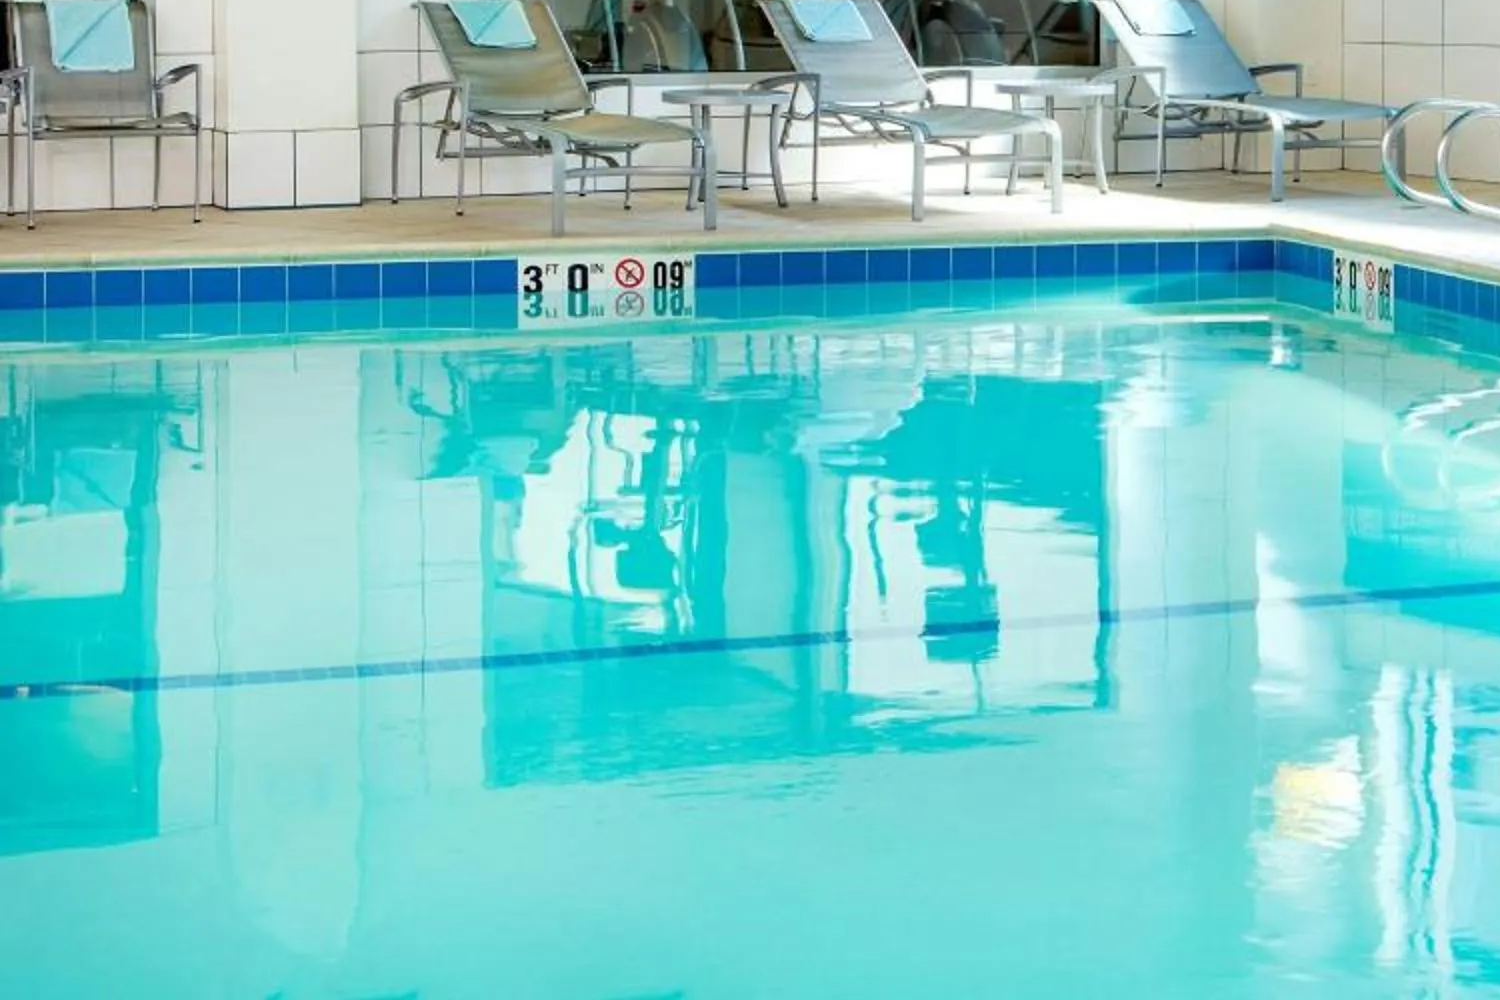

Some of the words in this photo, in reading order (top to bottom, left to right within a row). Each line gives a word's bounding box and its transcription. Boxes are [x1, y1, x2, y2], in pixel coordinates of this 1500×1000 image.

[523, 265, 543, 293] 3
[545, 263, 559, 275] FT
[568, 263, 588, 292] 0
[590, 263, 604, 273] IN
